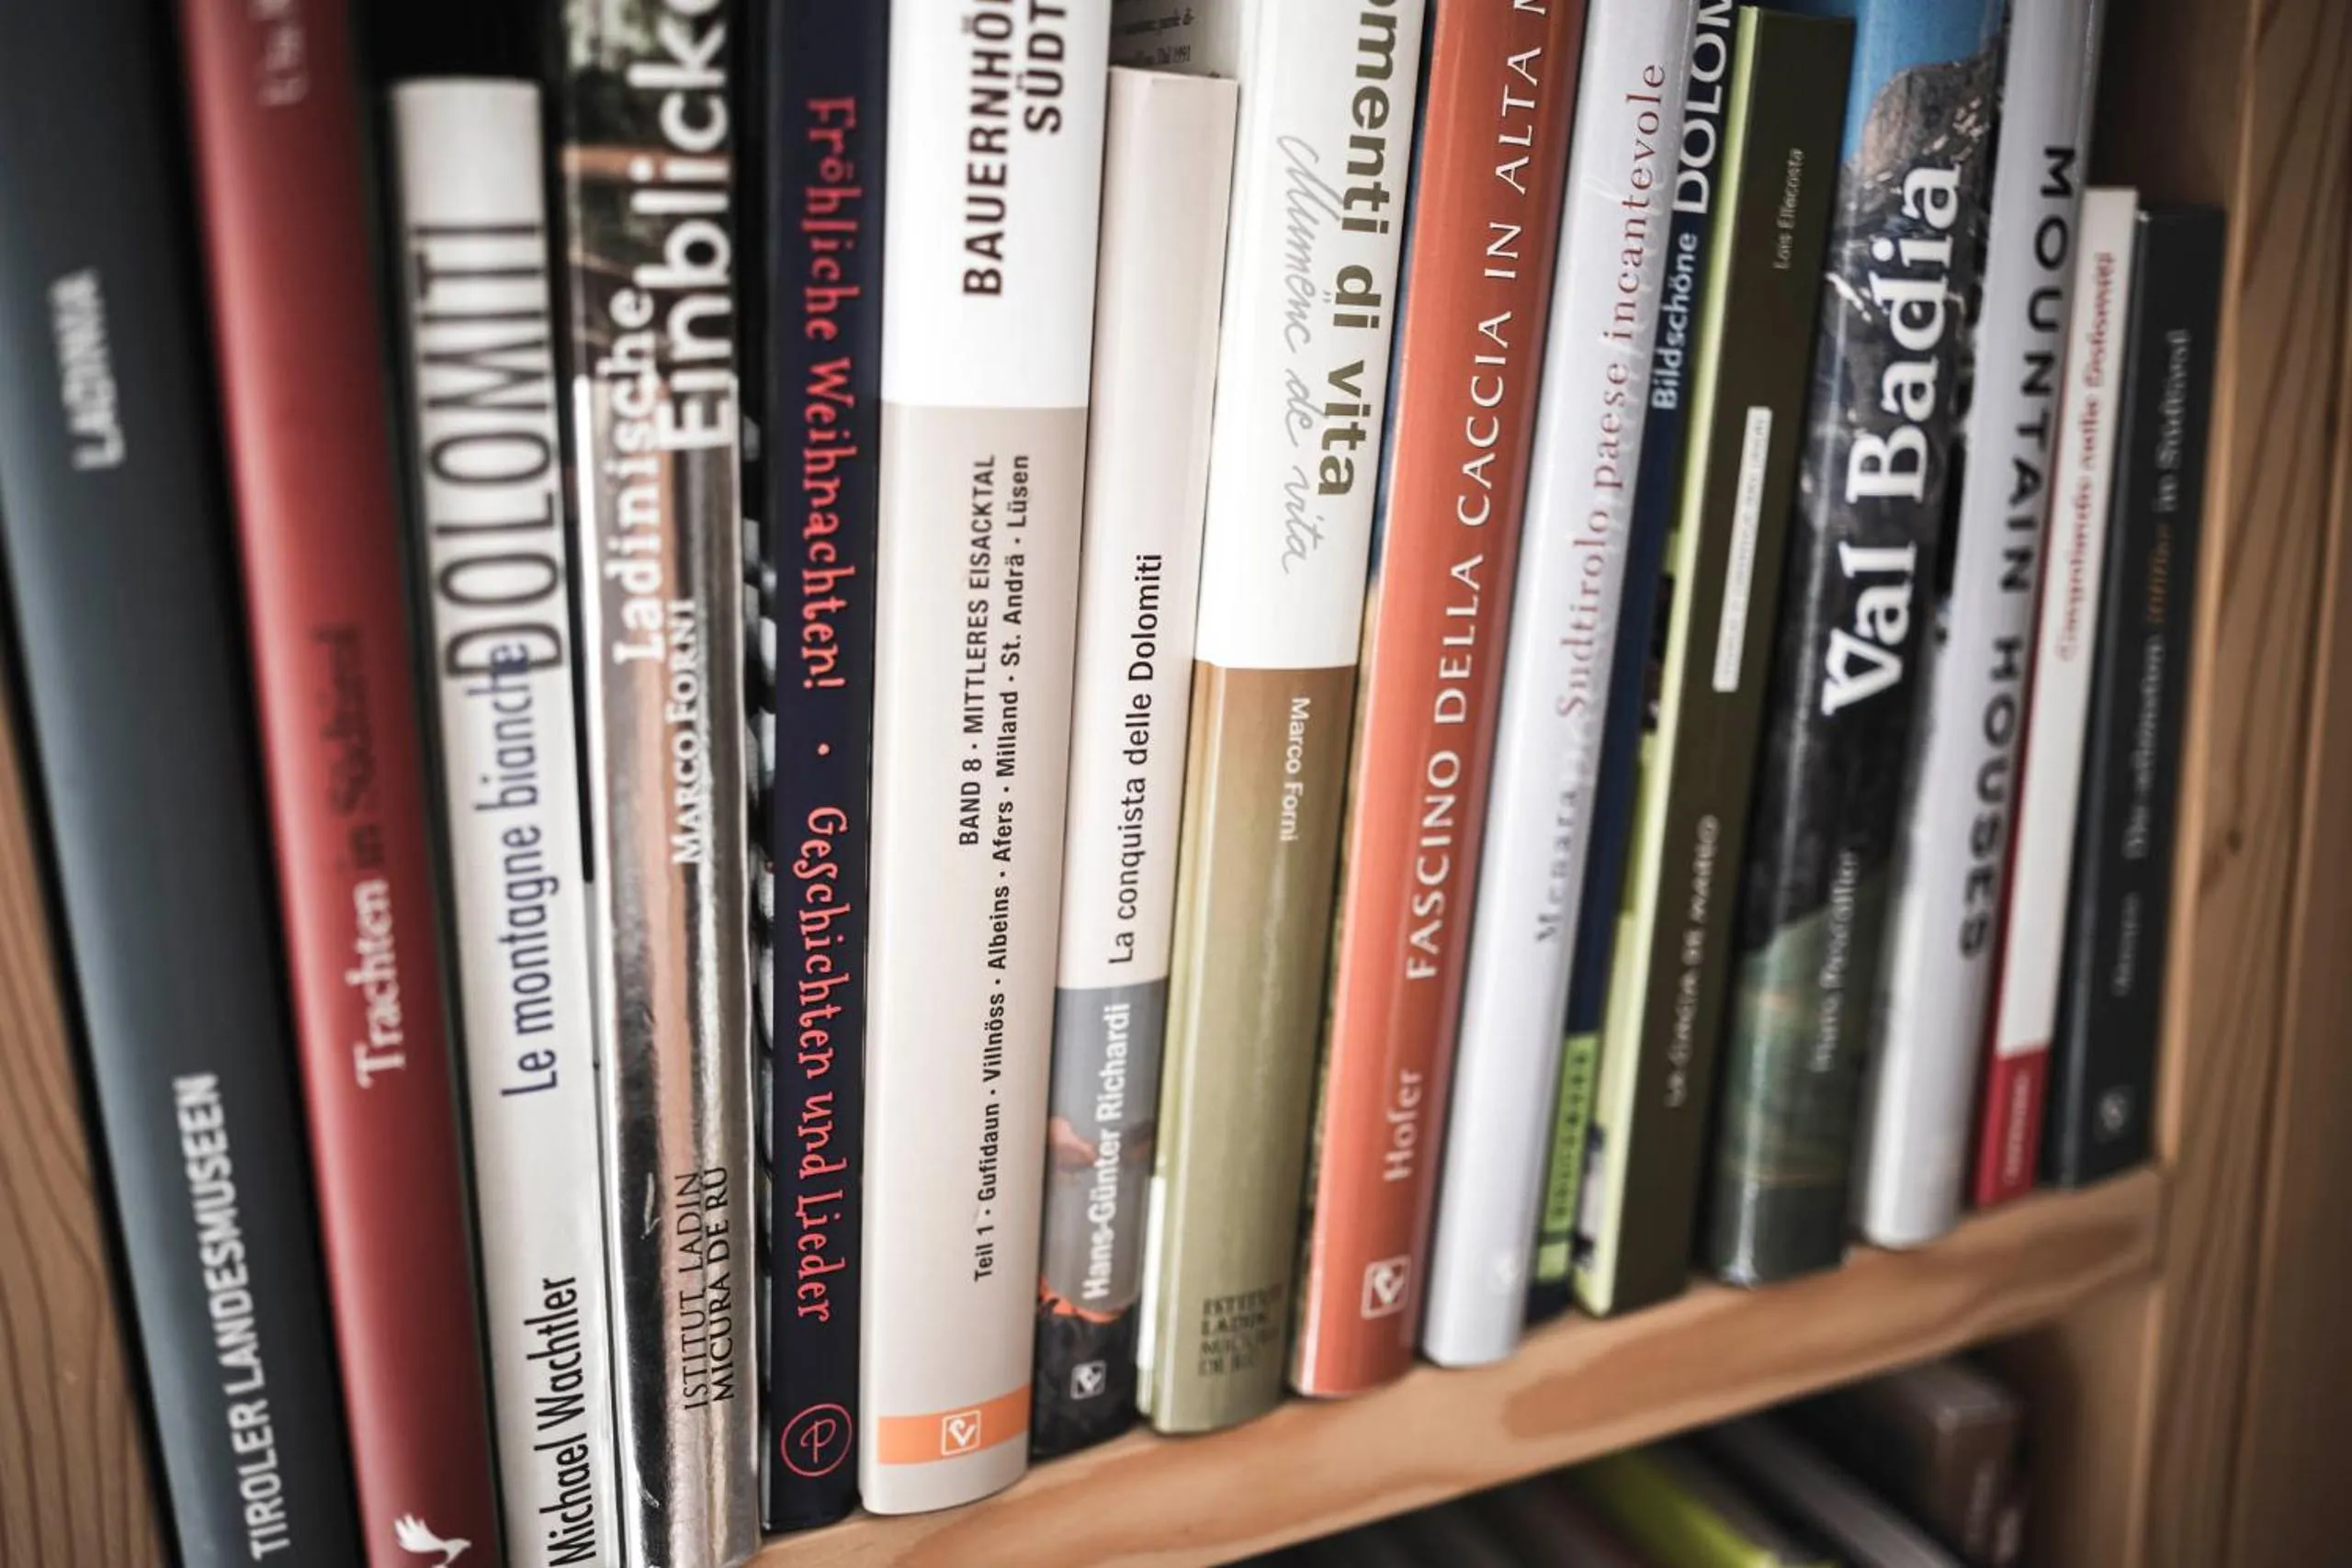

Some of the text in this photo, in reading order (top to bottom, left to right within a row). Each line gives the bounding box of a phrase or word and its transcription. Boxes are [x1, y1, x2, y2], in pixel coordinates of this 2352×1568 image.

[627, 0, 733, 450] Einblick
[962, 0, 1013, 296] BAUERNHÖ
[1496, 47, 1543, 195] ALTA
[1603, 62, 1666, 341] incantevole
[1317, 0, 1397, 496] menti di vita
[1484, 221, 1521, 278] IN
[1651, 232, 1699, 410] Bildschöne
[411, 223, 564, 678] DOLOMITI
[595, 285, 664, 666] Ladinische
[1284, 367, 1330, 448] de
[1457, 310, 1512, 526] CACCIA
[1593, 362, 1630, 489] paese
[1821, 163, 1962, 716] Val Badia
[2000, 147, 2076, 592] MOUNTAIN
[1001, 554, 1025, 626] Andrä
[1006, 456, 1029, 528] Lüsen
[1282, 465, 1326, 575] vita
[792, 96, 863, 1323] Fröhliche Weihnachten! Geschichten und Lieder
[958, 454, 996, 846] BAND 8 MITTLERES EISACKTAL
[995, 690, 1019, 778] Milland
[1001, 634, 1023, 668] St.
[1434, 553, 1485, 725] DELLA
[672, 729, 703, 864] MARCO
[992, 798, 1014, 863] Afers
[1107, 553, 1163, 965] La conquista delle Dolomiti
[1280, 697, 1311, 841] Marco Forni
[1406, 749, 1461, 980] FASCINO
[1959, 637, 2020, 961] HOUSES
[465, 641, 559, 1099] Le montagne bianche
[987, 885, 1011, 972] Albeins
[344, 879, 406, 1089] Trachten
[982, 992, 1005, 1091] Villnöss
[977, 1101, 1001, 1203] Gufidaun
[1081, 1002, 1131, 1301] Hans-Günter Richardi
[1383, 1069, 1423, 1181] Hofer
[173, 1072, 289, 1561] TIROLER LANDESMUSEEN
[674, 1173, 709, 1410] ISTITUT LADIN
[704, 1167, 735, 1401] MICURA DE RU
[974, 1241, 994, 1283] Teil
[524, 1277, 596, 1567] Michael Wachtler
